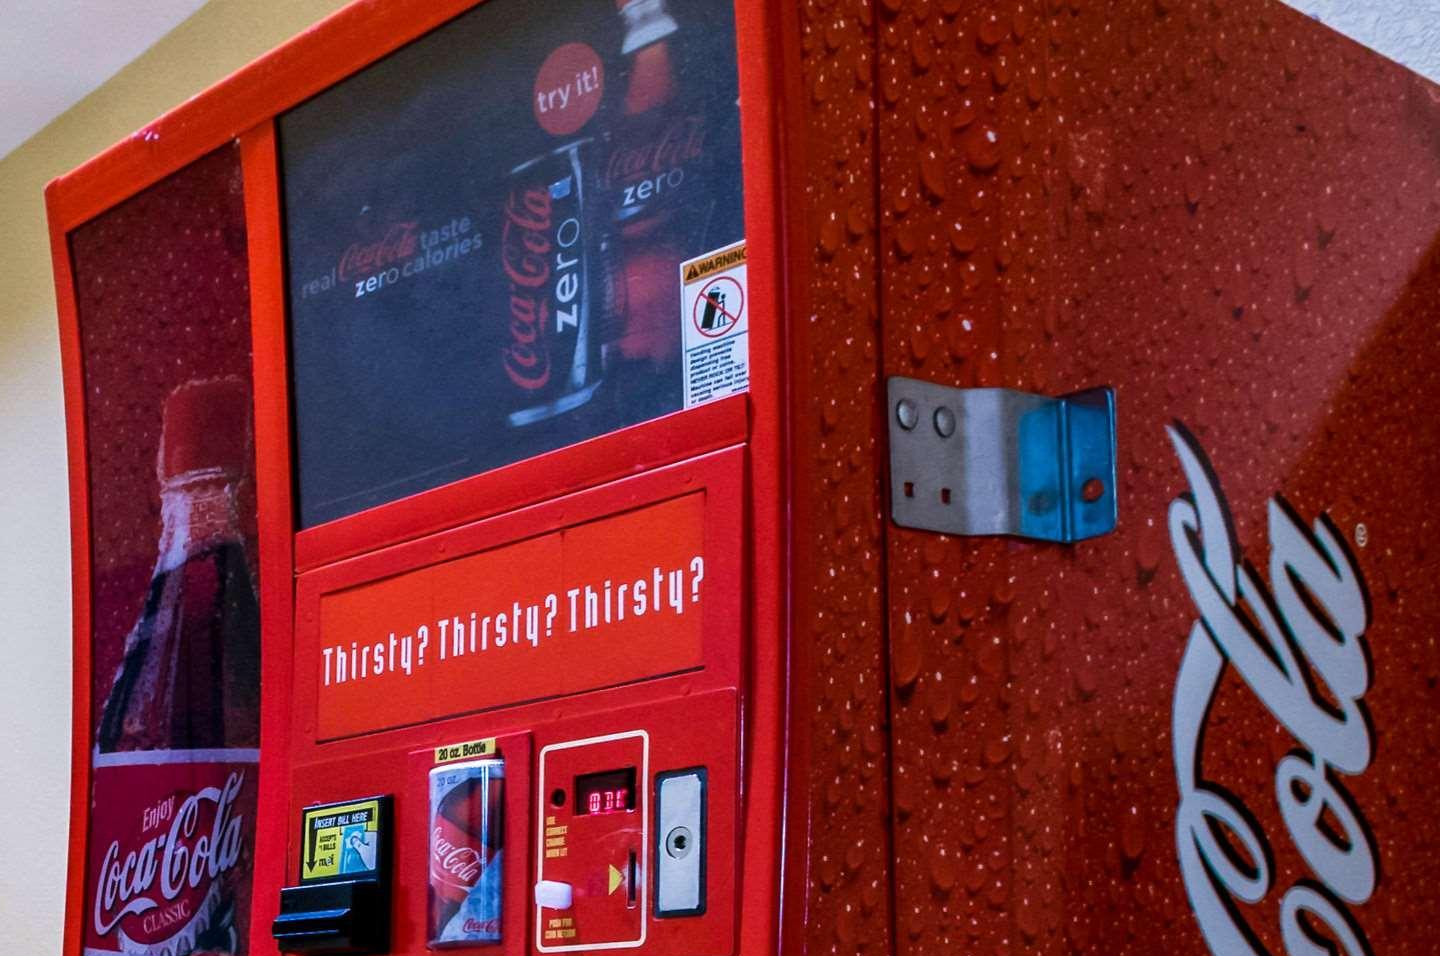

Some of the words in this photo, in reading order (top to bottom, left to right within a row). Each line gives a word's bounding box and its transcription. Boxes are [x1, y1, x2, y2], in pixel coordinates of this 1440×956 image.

[537, 84, 570, 113] try
[575, 66, 600, 96] it!
[623, 168, 684, 206] zero
[302, 268, 336, 298] real
[421, 216, 471, 249] taste
[355, 267, 399, 297] zero
[403, 233, 482, 277] calories
[555, 217, 580, 333] zero
[323, 625, 428, 687] Thirsty?
[437, 593, 557, 661] Thirsty?
[567, 556, 705, 633] Thirsty?
[438, 748, 448, 761] 20
[462, 742, 486, 757] Bottle
[143, 795, 175, 832] Enjoy
[94, 768, 245, 935] Coca-Cola
[143, 899, 191, 934] CLASSIC
